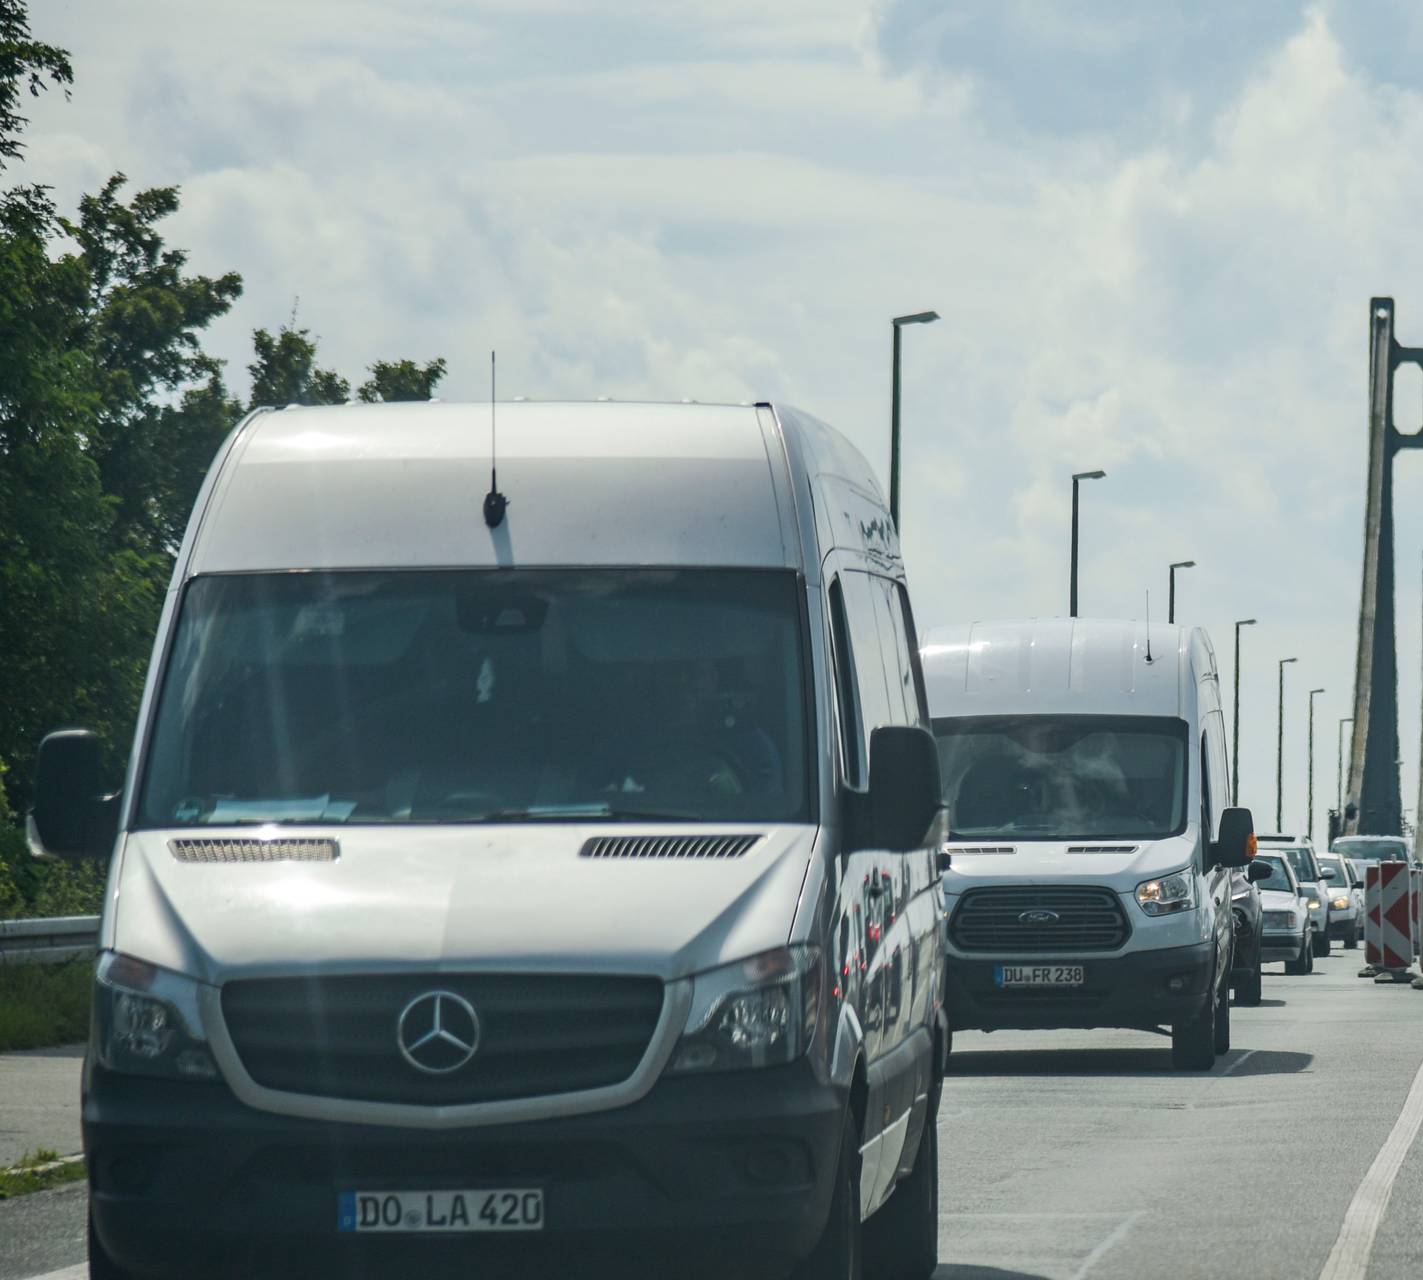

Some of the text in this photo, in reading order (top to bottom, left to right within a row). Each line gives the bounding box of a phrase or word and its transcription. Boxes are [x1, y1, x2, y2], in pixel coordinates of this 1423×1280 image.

[1004, 967, 1082, 982] DU FR 238
[359, 1193, 541, 1227] DO LA 420
